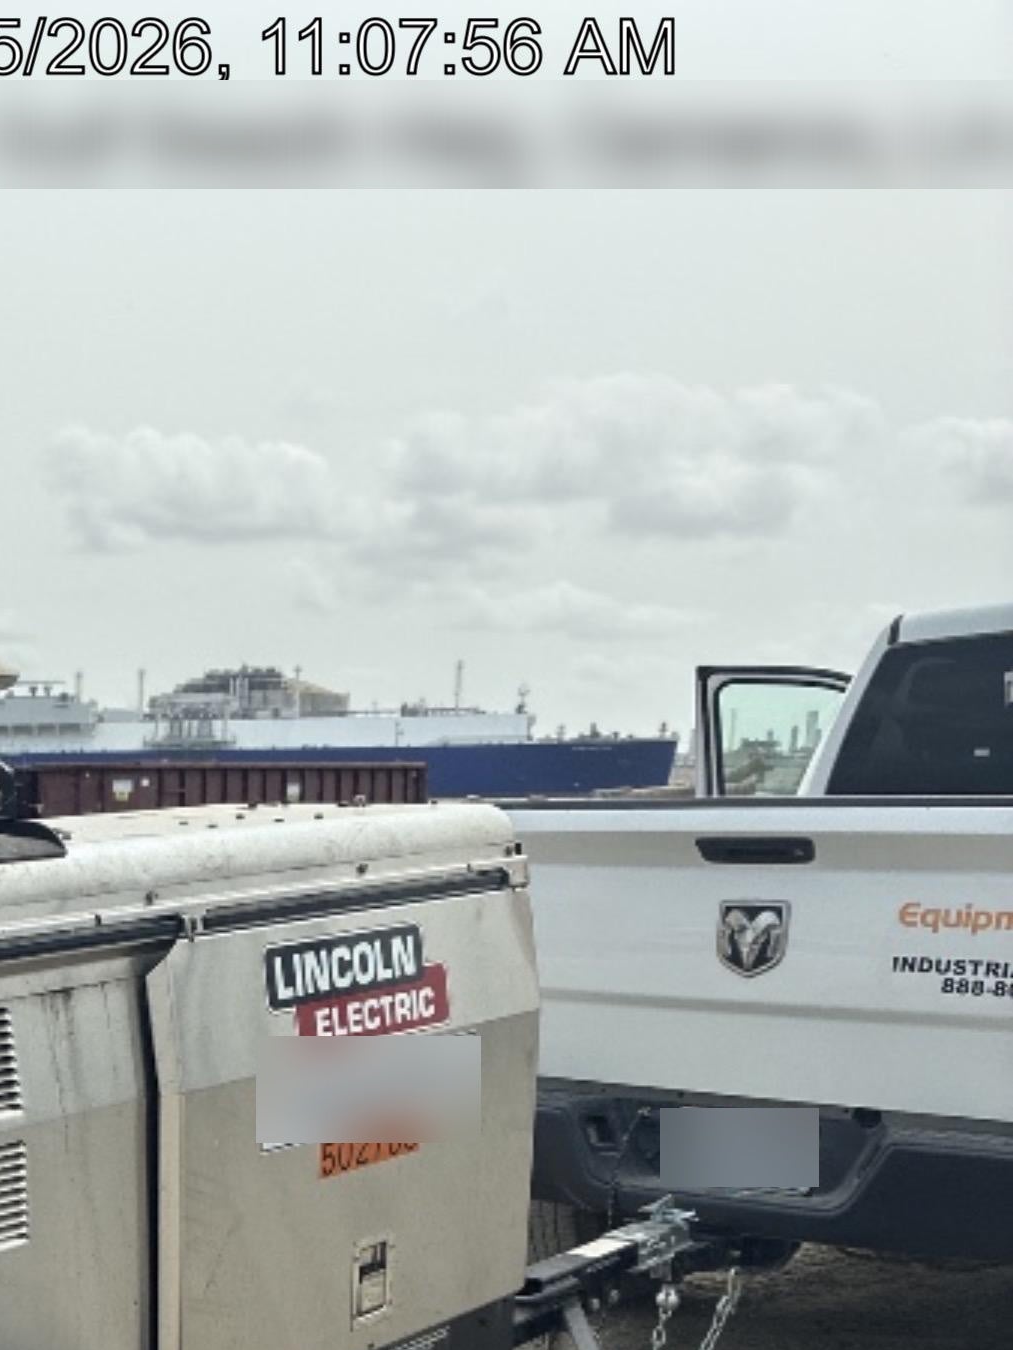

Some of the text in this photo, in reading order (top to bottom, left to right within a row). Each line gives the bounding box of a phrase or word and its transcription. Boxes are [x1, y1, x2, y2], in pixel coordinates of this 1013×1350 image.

[274, 935, 418, 1000] LINCOLN
[892, 956, 1013, 978] INDUSTRI
[315, 985, 436, 1037] ELECTRIC
